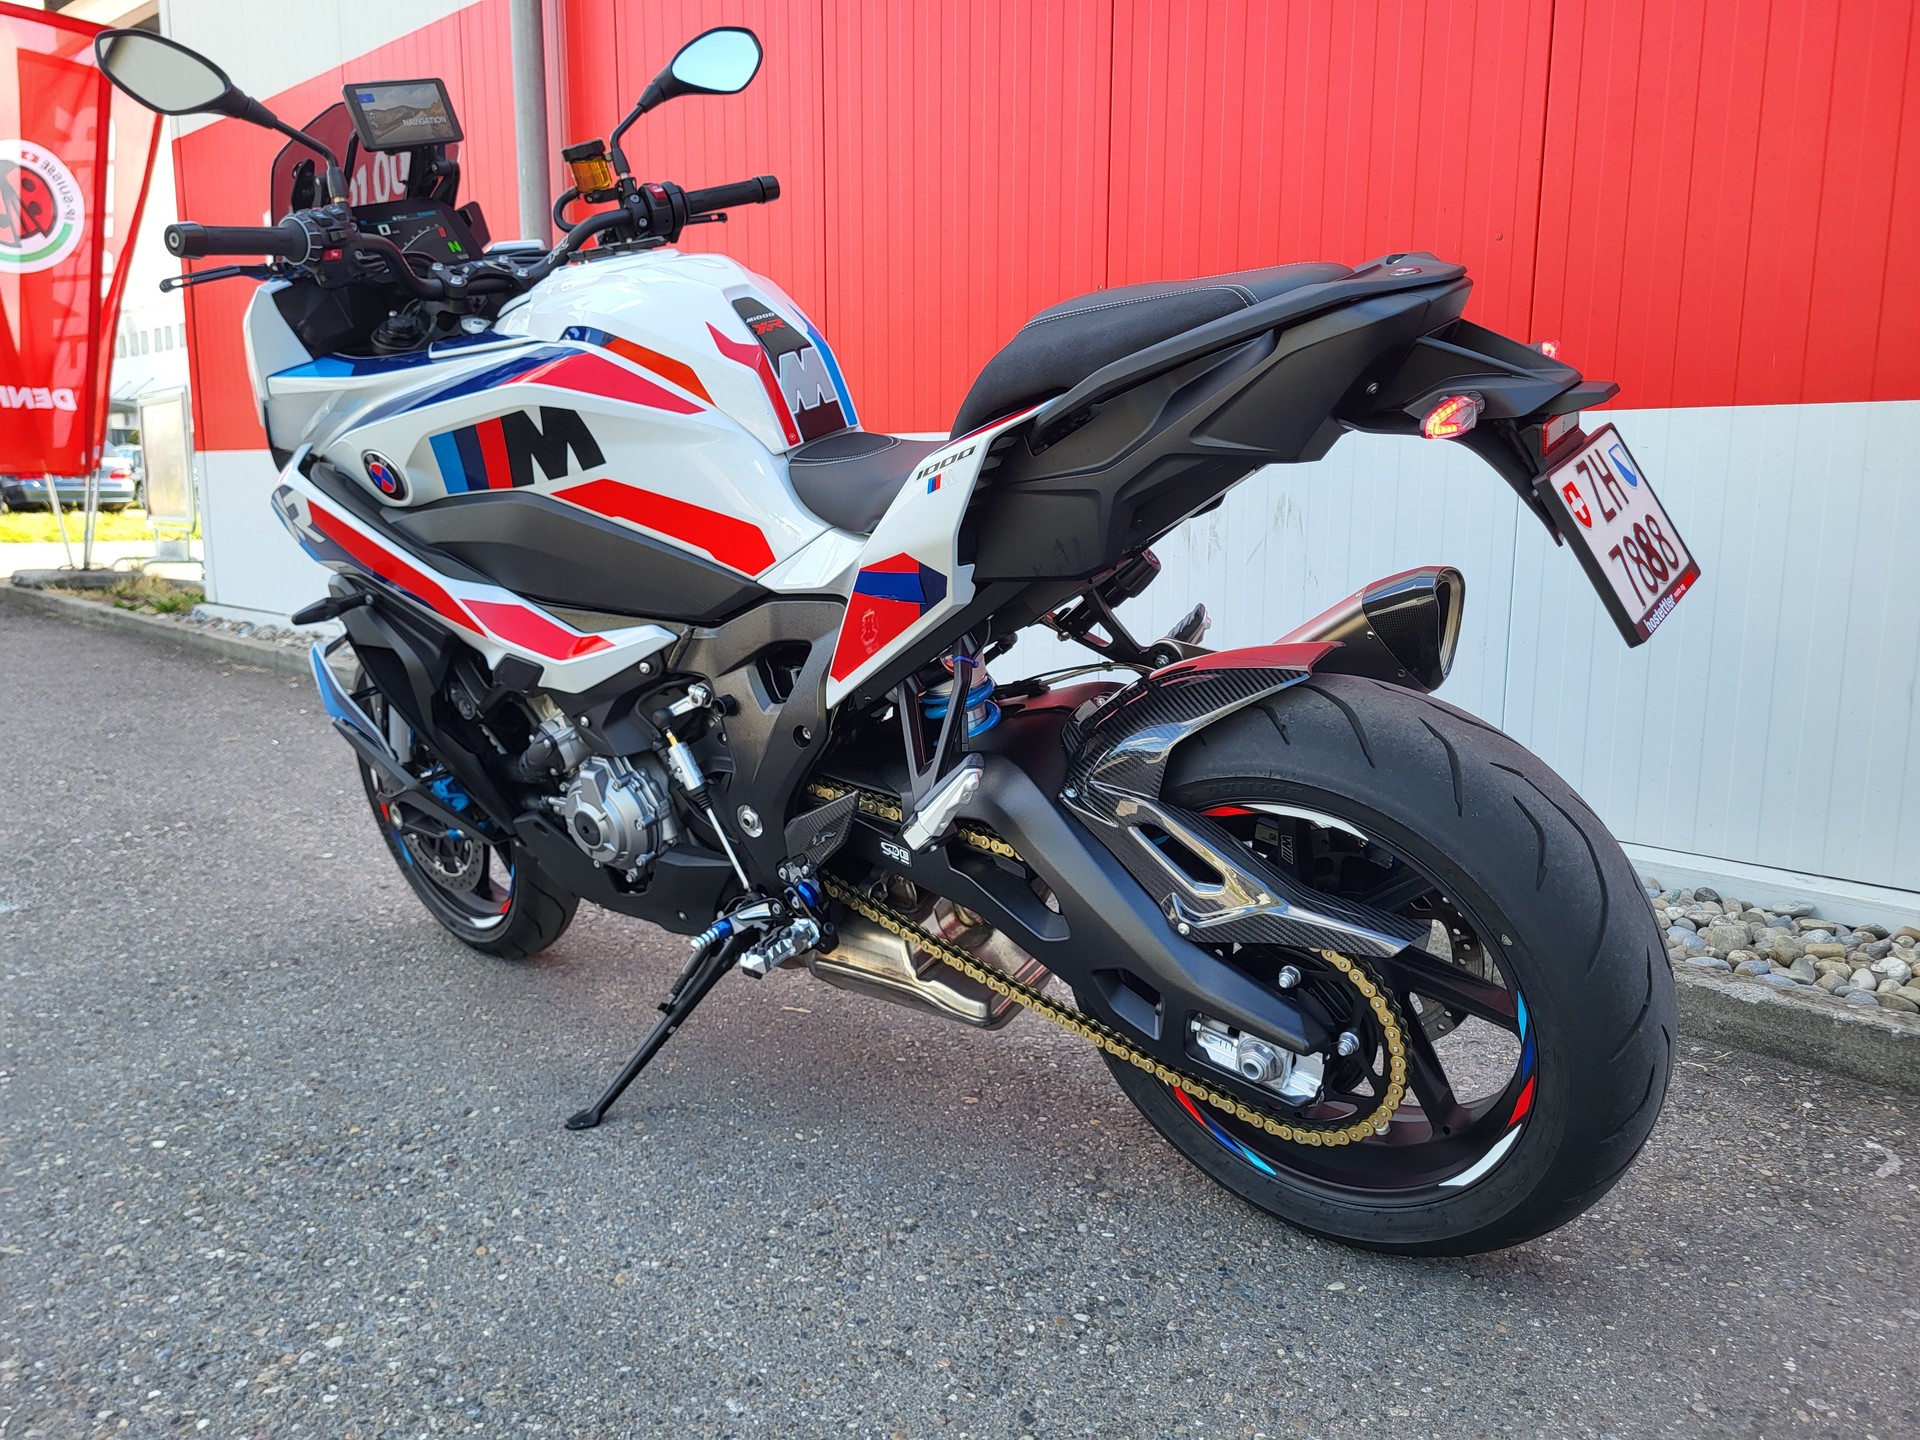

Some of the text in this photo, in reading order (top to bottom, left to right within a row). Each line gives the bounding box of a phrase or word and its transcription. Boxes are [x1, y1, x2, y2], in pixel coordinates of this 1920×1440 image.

[402, 116, 447, 127] NAVIGATION
[447, 240, 462, 253] N
[746, 312, 775, 323] M1000
[779, 347, 838, 415] M
[500, 405, 607, 489] M
[916, 445, 976, 481] 1000
[1575, 449, 1630, 524] ZH
[1608, 513, 1680, 608] 7888
[1643, 594, 1676, 634] hostettler
